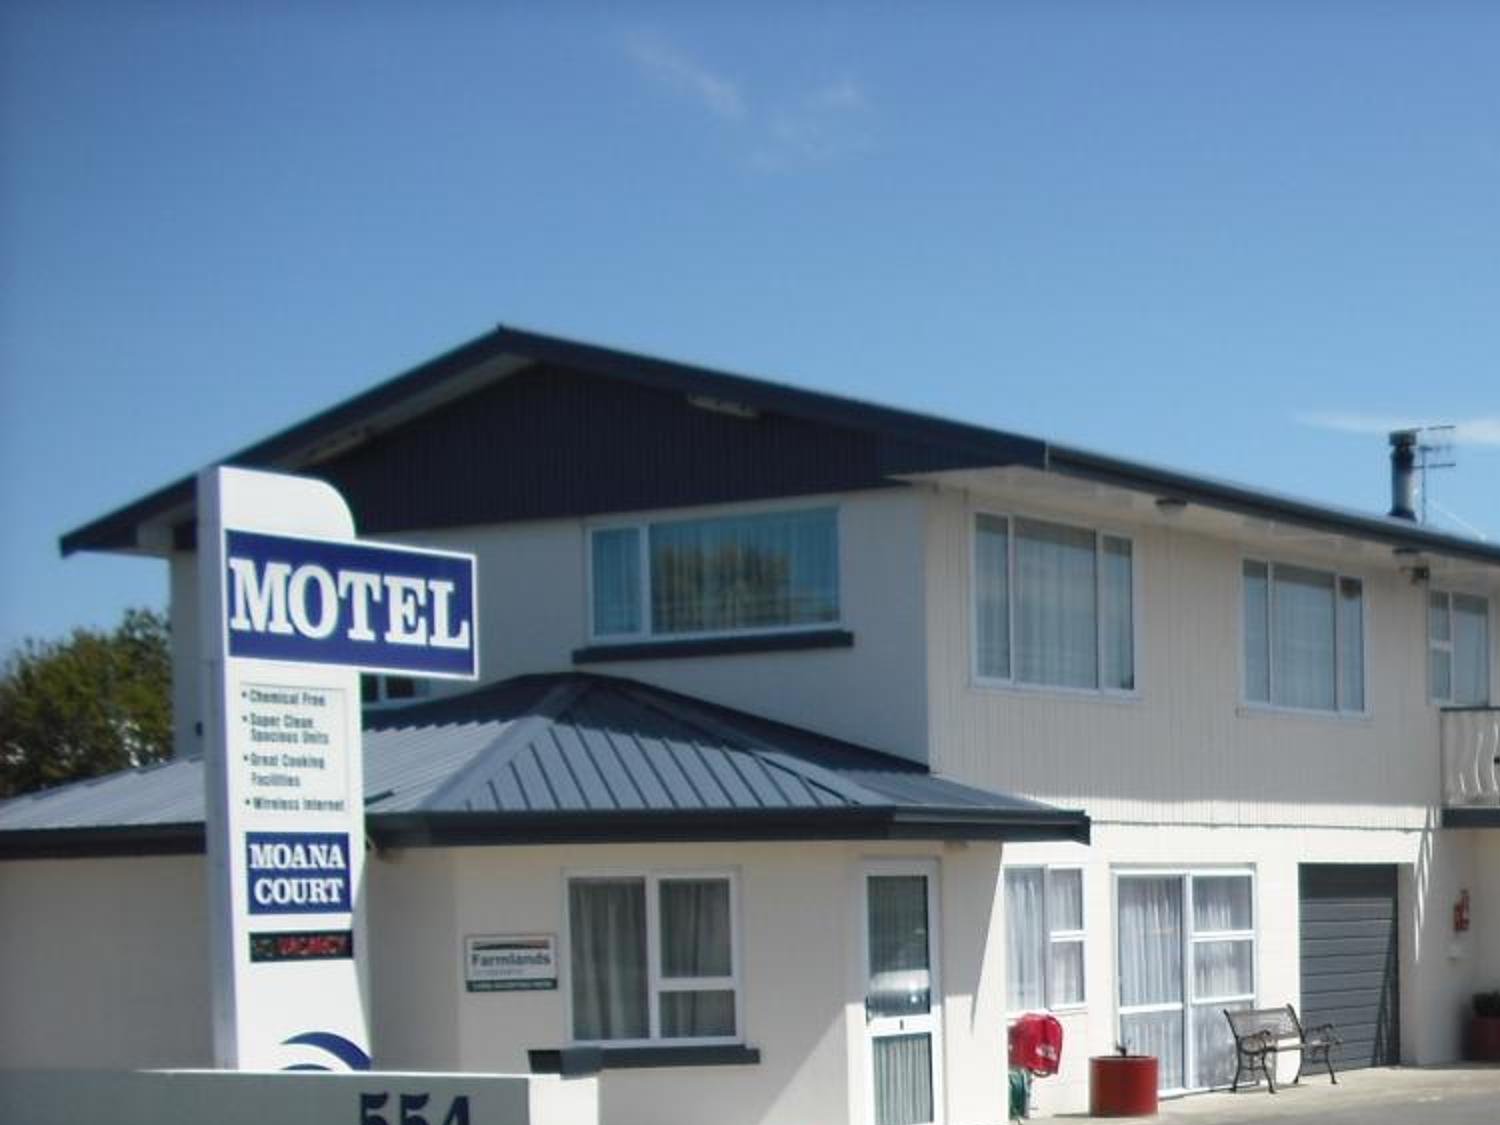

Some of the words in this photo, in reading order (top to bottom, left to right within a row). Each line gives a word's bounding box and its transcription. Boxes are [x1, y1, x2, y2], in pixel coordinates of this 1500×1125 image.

[228, 556, 470, 649] MOTEL
[302, 692, 326, 707] Free
[249, 843, 346, 870] MOANA
[254, 878, 344, 905] COURT
